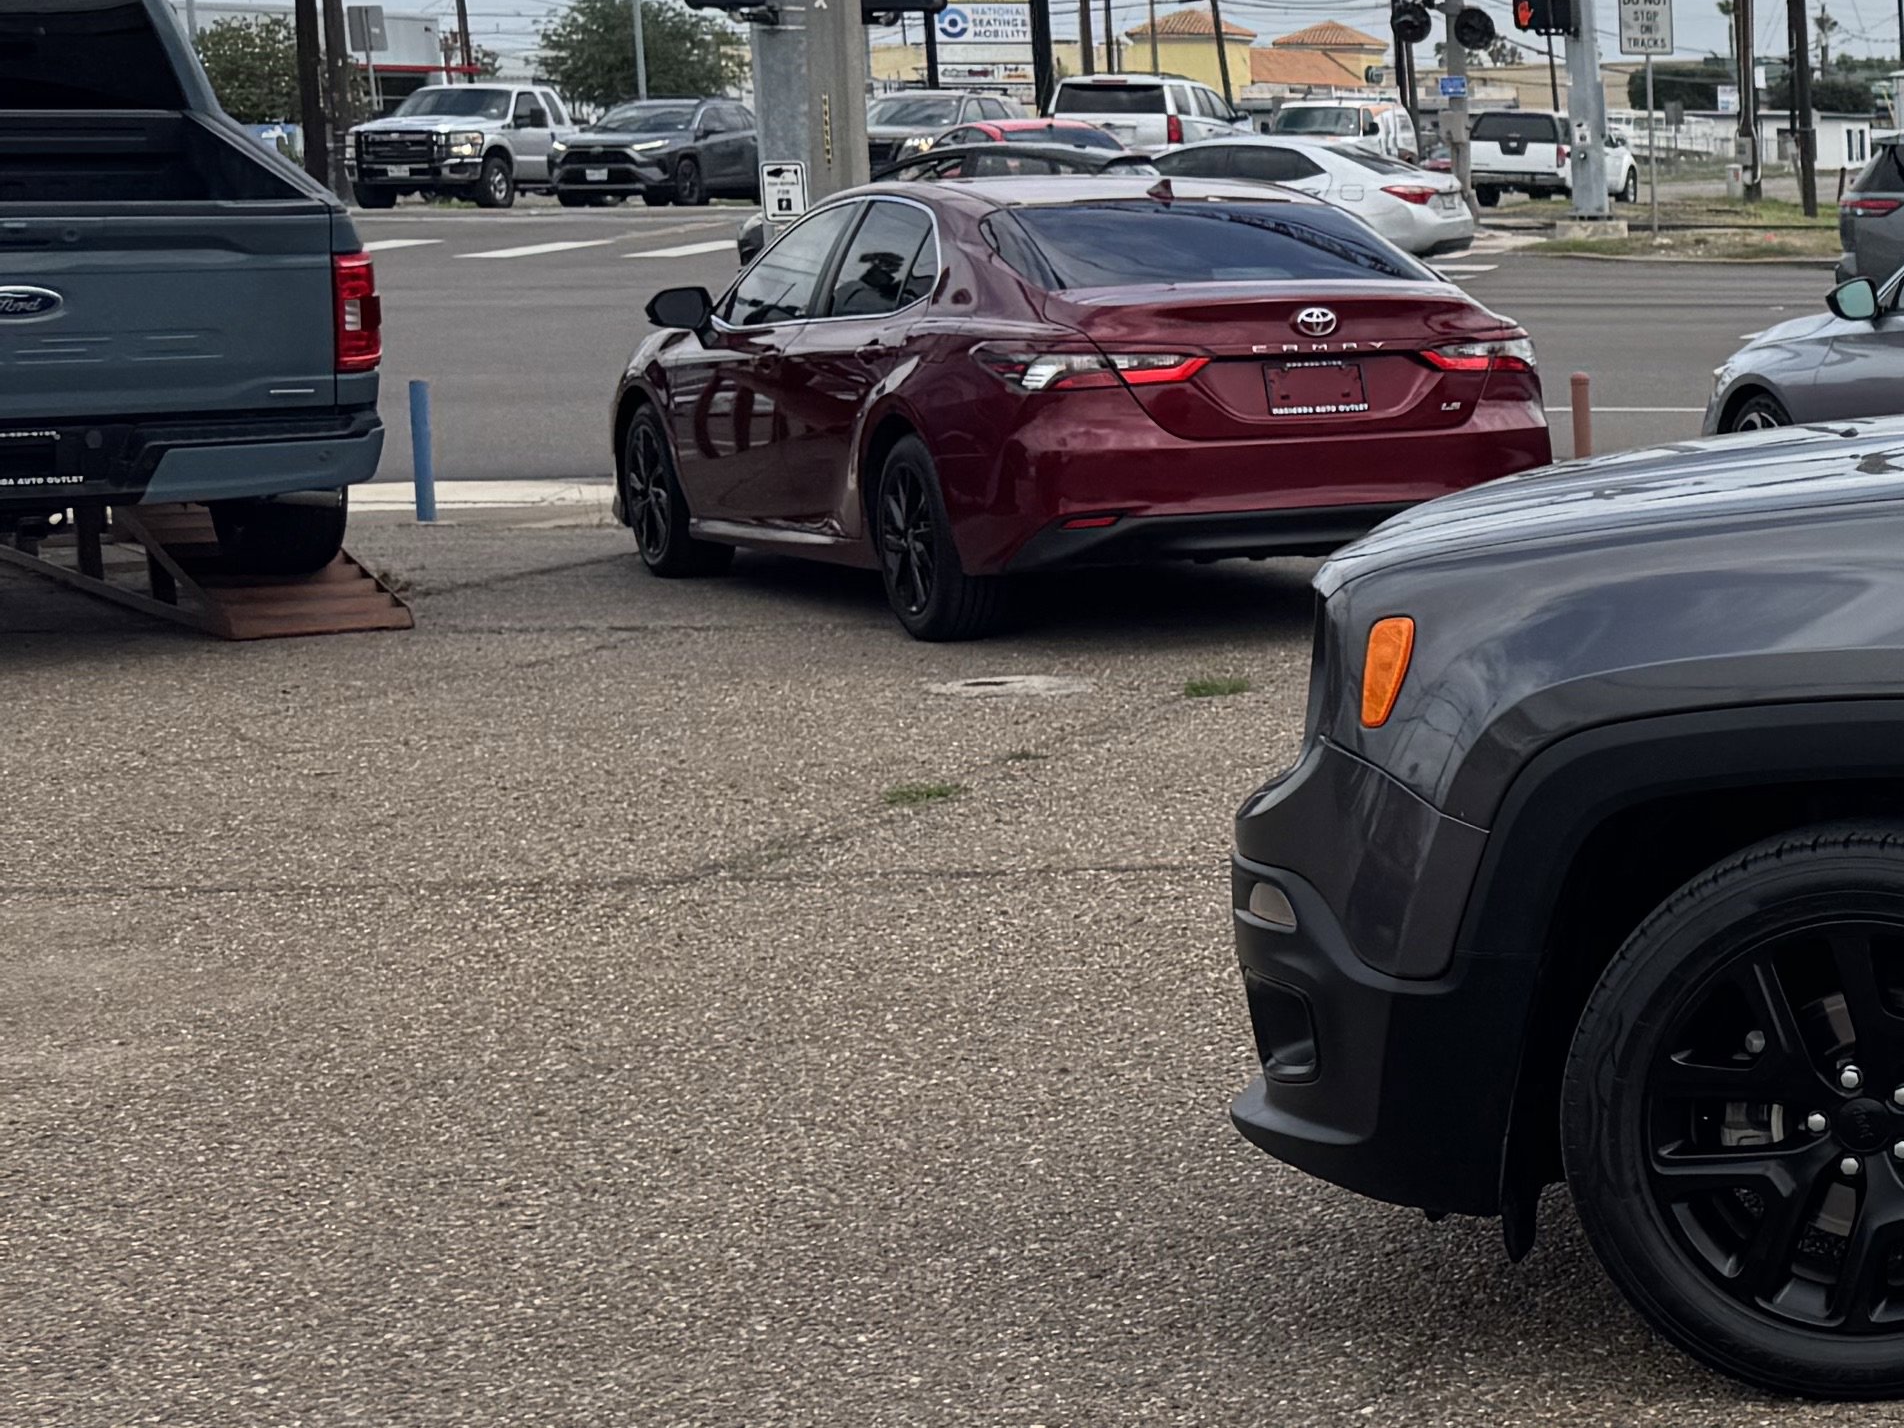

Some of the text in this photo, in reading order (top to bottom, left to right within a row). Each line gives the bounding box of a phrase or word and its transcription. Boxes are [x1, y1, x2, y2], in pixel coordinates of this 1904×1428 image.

[971, 8, 1025, 16] NATIONAL
[1633, 10, 1659, 22] STOP
[972, 18, 1019, 28] SEATING
[973, 30, 1028, 39] MOBILITY
[1627, 37, 1667, 49] TRACKS
[1252, 341, 1385, 352] CAMRY
[17, 477, 44, 485] AUTO
[46, 475, 84, 484] OUTLET
